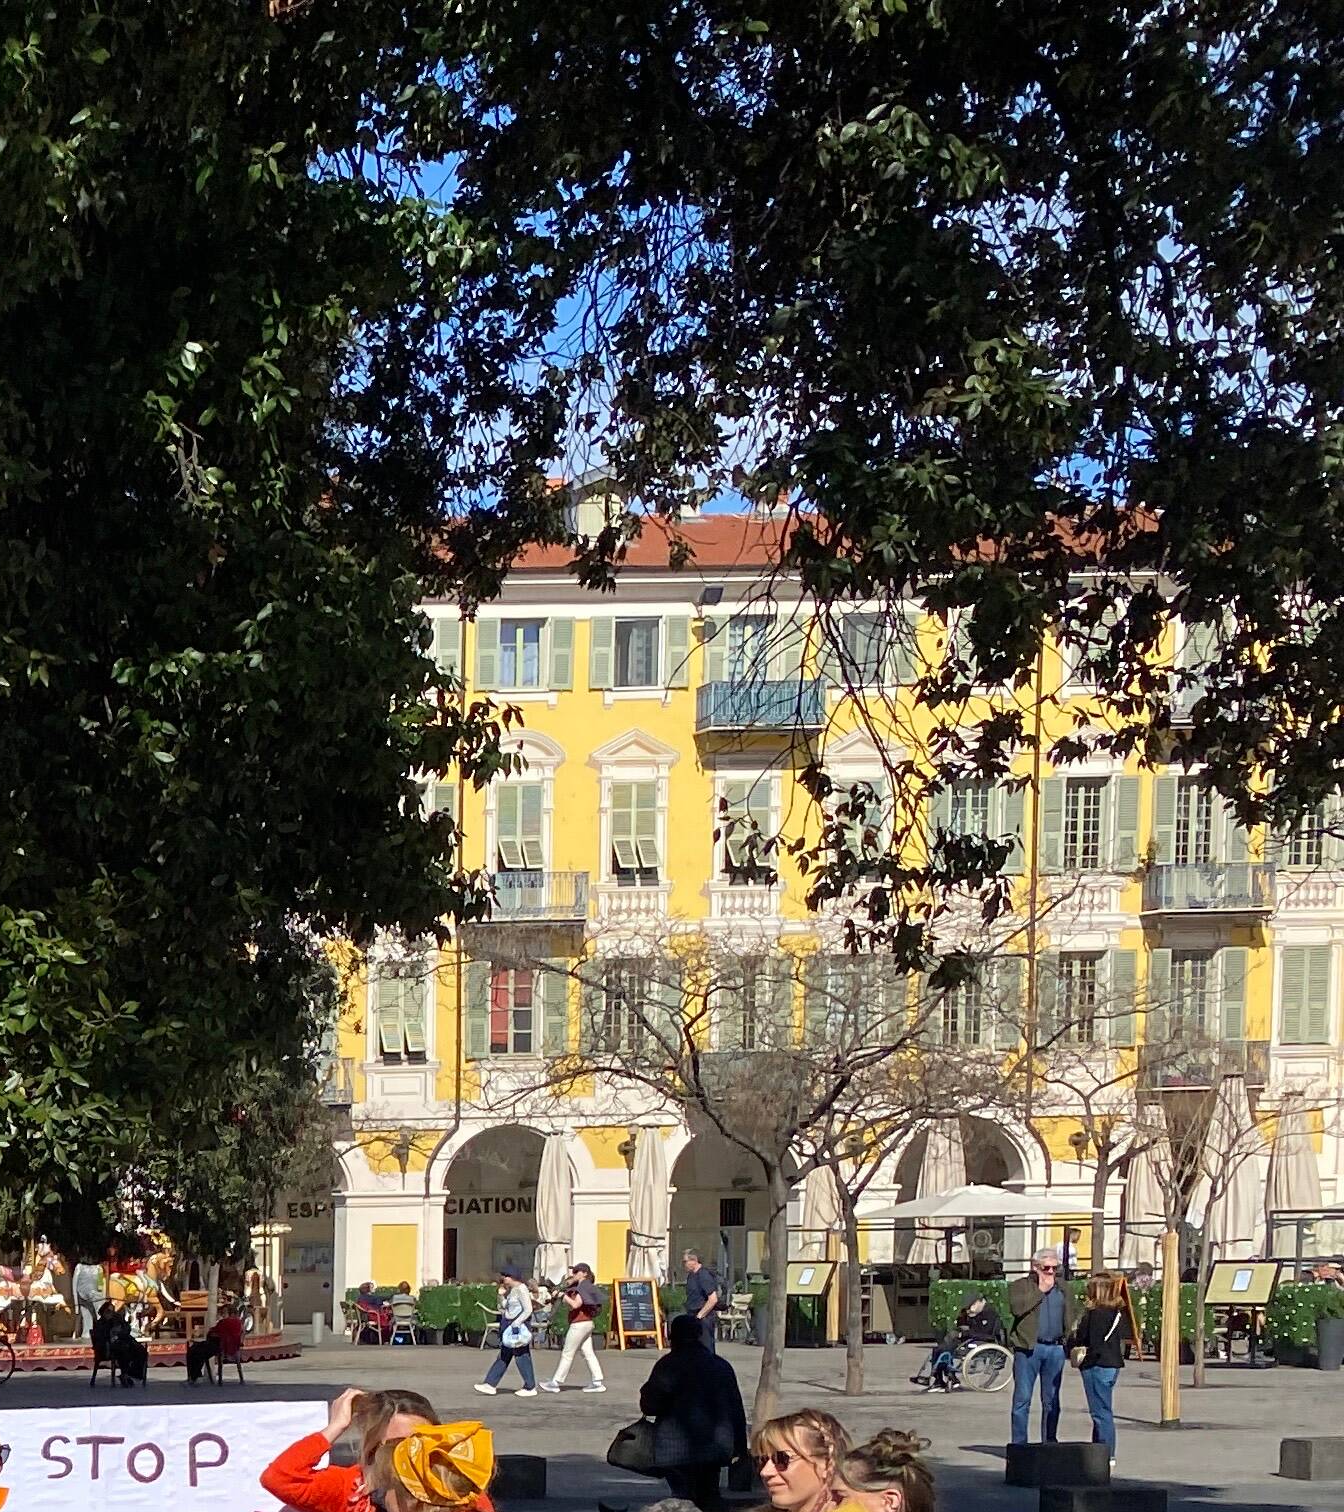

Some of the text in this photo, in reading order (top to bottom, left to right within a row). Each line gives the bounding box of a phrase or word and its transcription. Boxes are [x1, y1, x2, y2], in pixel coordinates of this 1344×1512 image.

[287, 1196, 536, 1219] ESP CIATION
[41, 1432, 229, 1487] STOP
